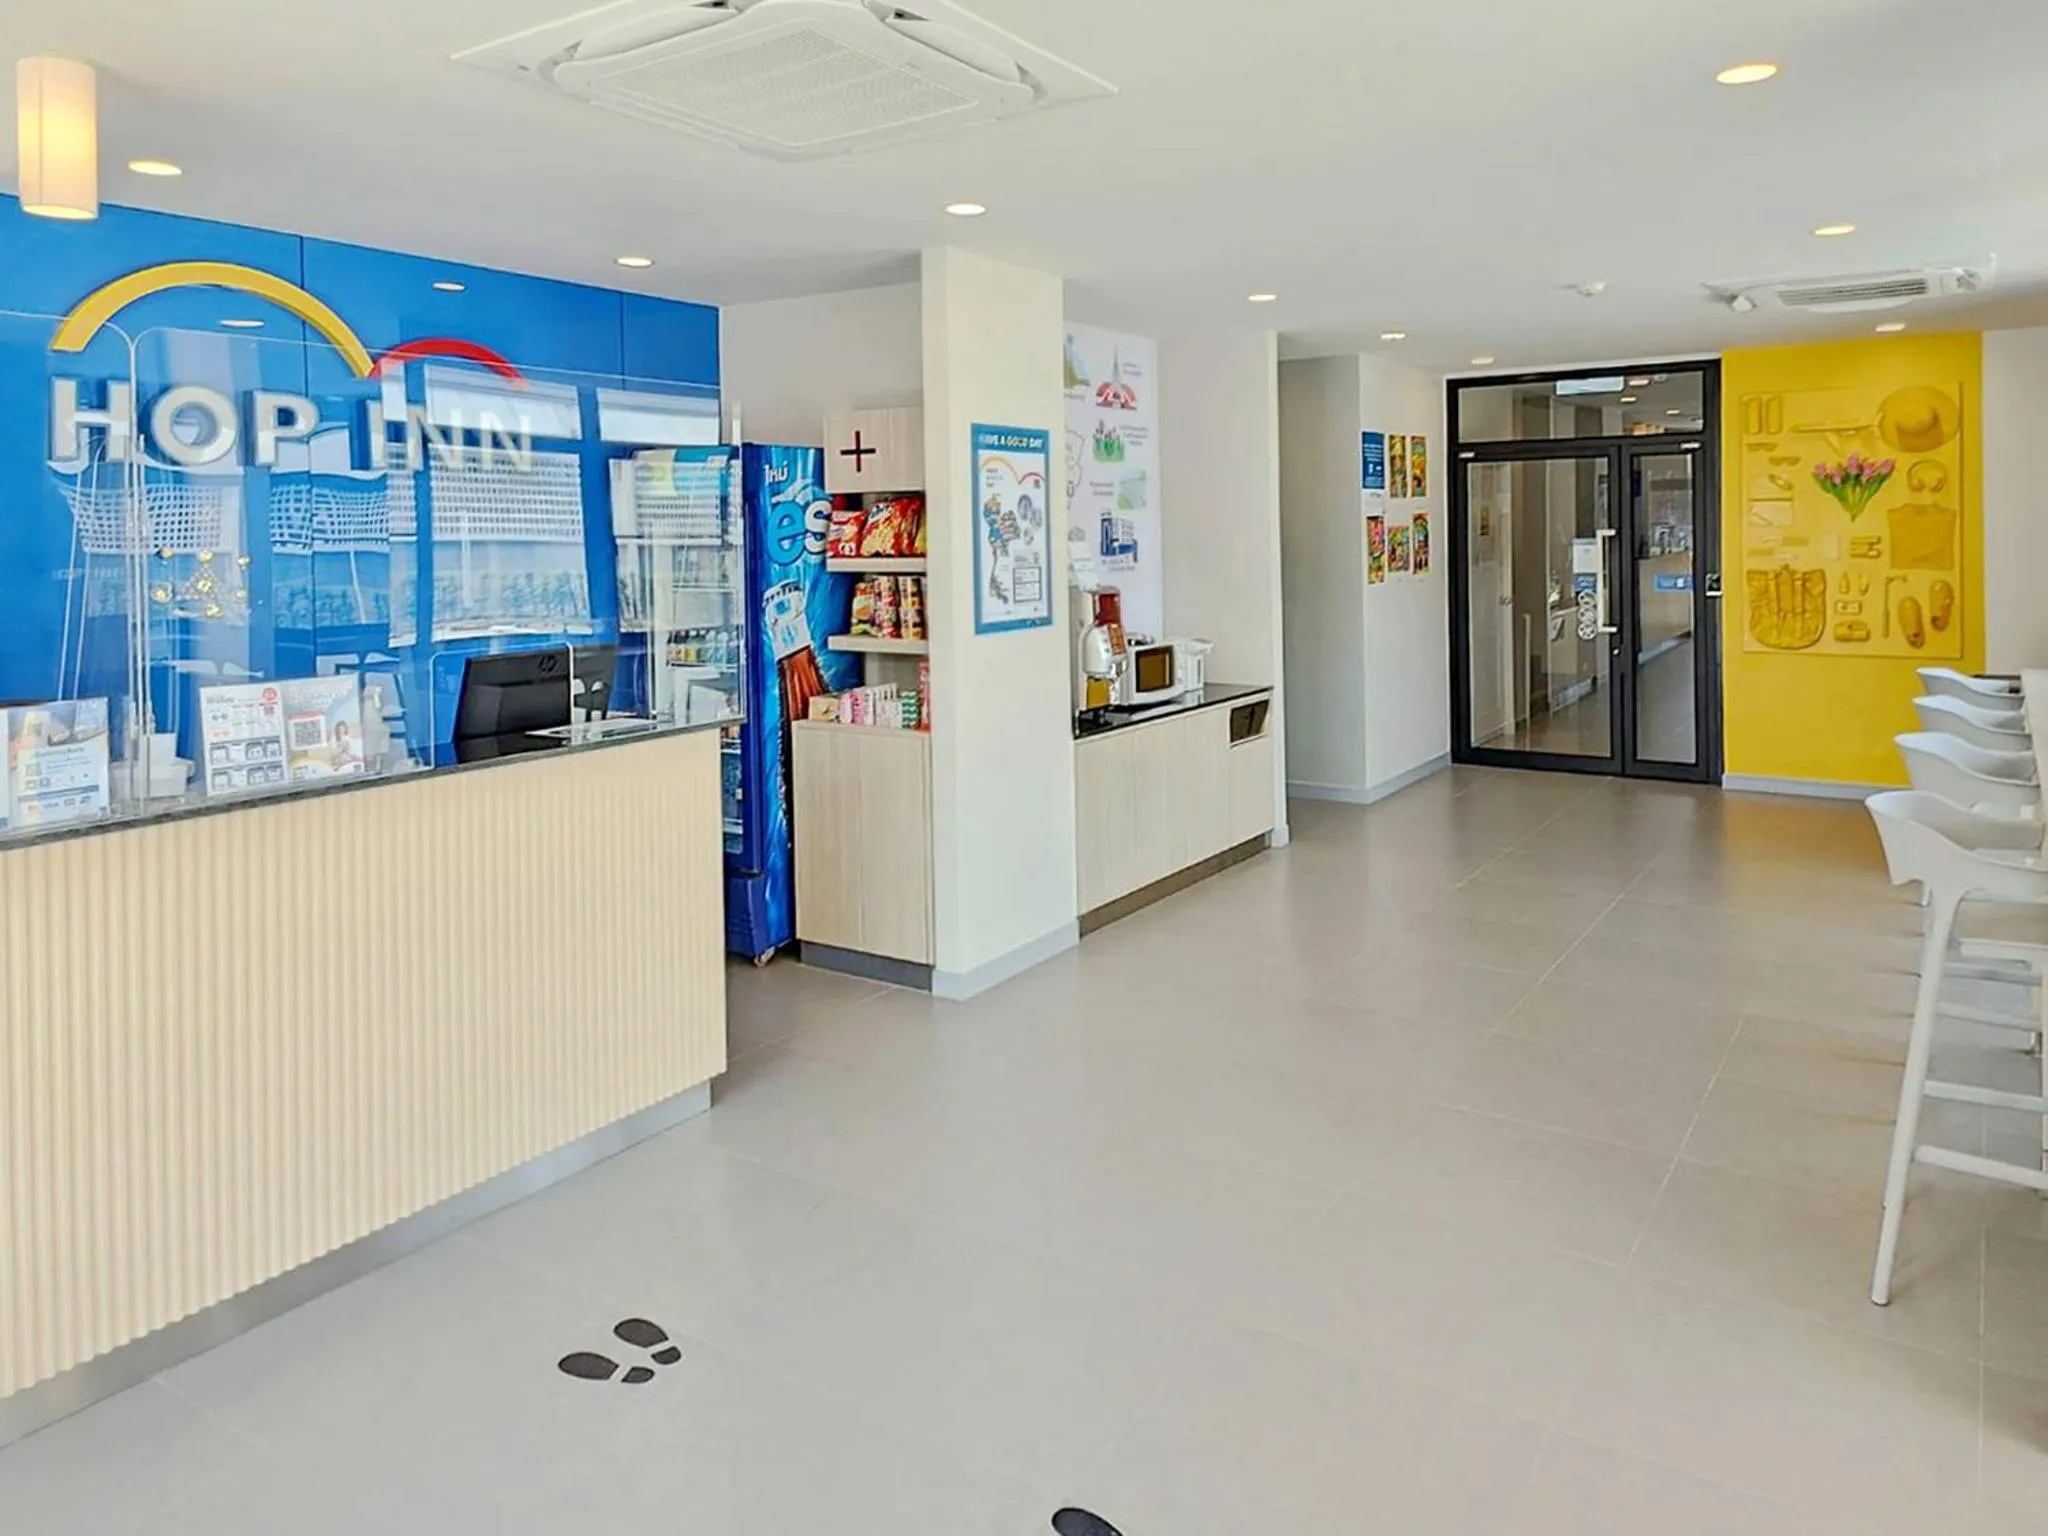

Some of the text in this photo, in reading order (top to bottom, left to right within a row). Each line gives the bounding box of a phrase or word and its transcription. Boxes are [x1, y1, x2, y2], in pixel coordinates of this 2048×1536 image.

[50, 375, 534, 472] HOP INN
[764, 460, 788, 486] ใหม่
